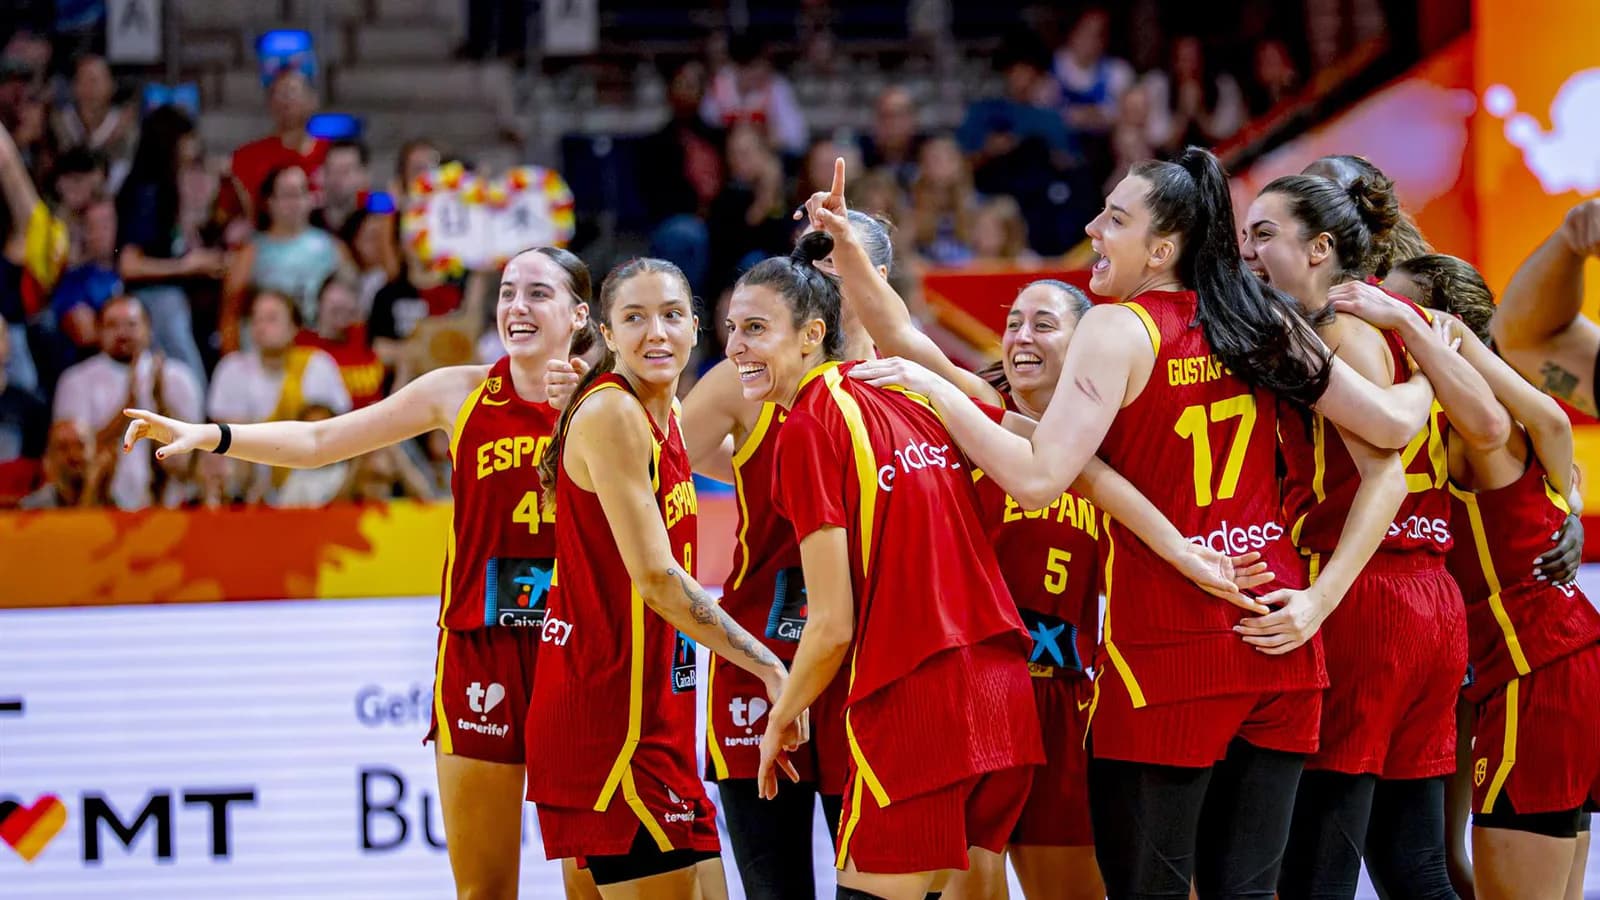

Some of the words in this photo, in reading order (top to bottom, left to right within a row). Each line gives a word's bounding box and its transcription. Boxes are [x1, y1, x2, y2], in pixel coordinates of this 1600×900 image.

[1167, 354, 1232, 386] GUSTAF
[1174, 394, 1257, 507] 17
[1044, 547, 1072, 595] 5
[83, 792, 255, 861] MT
